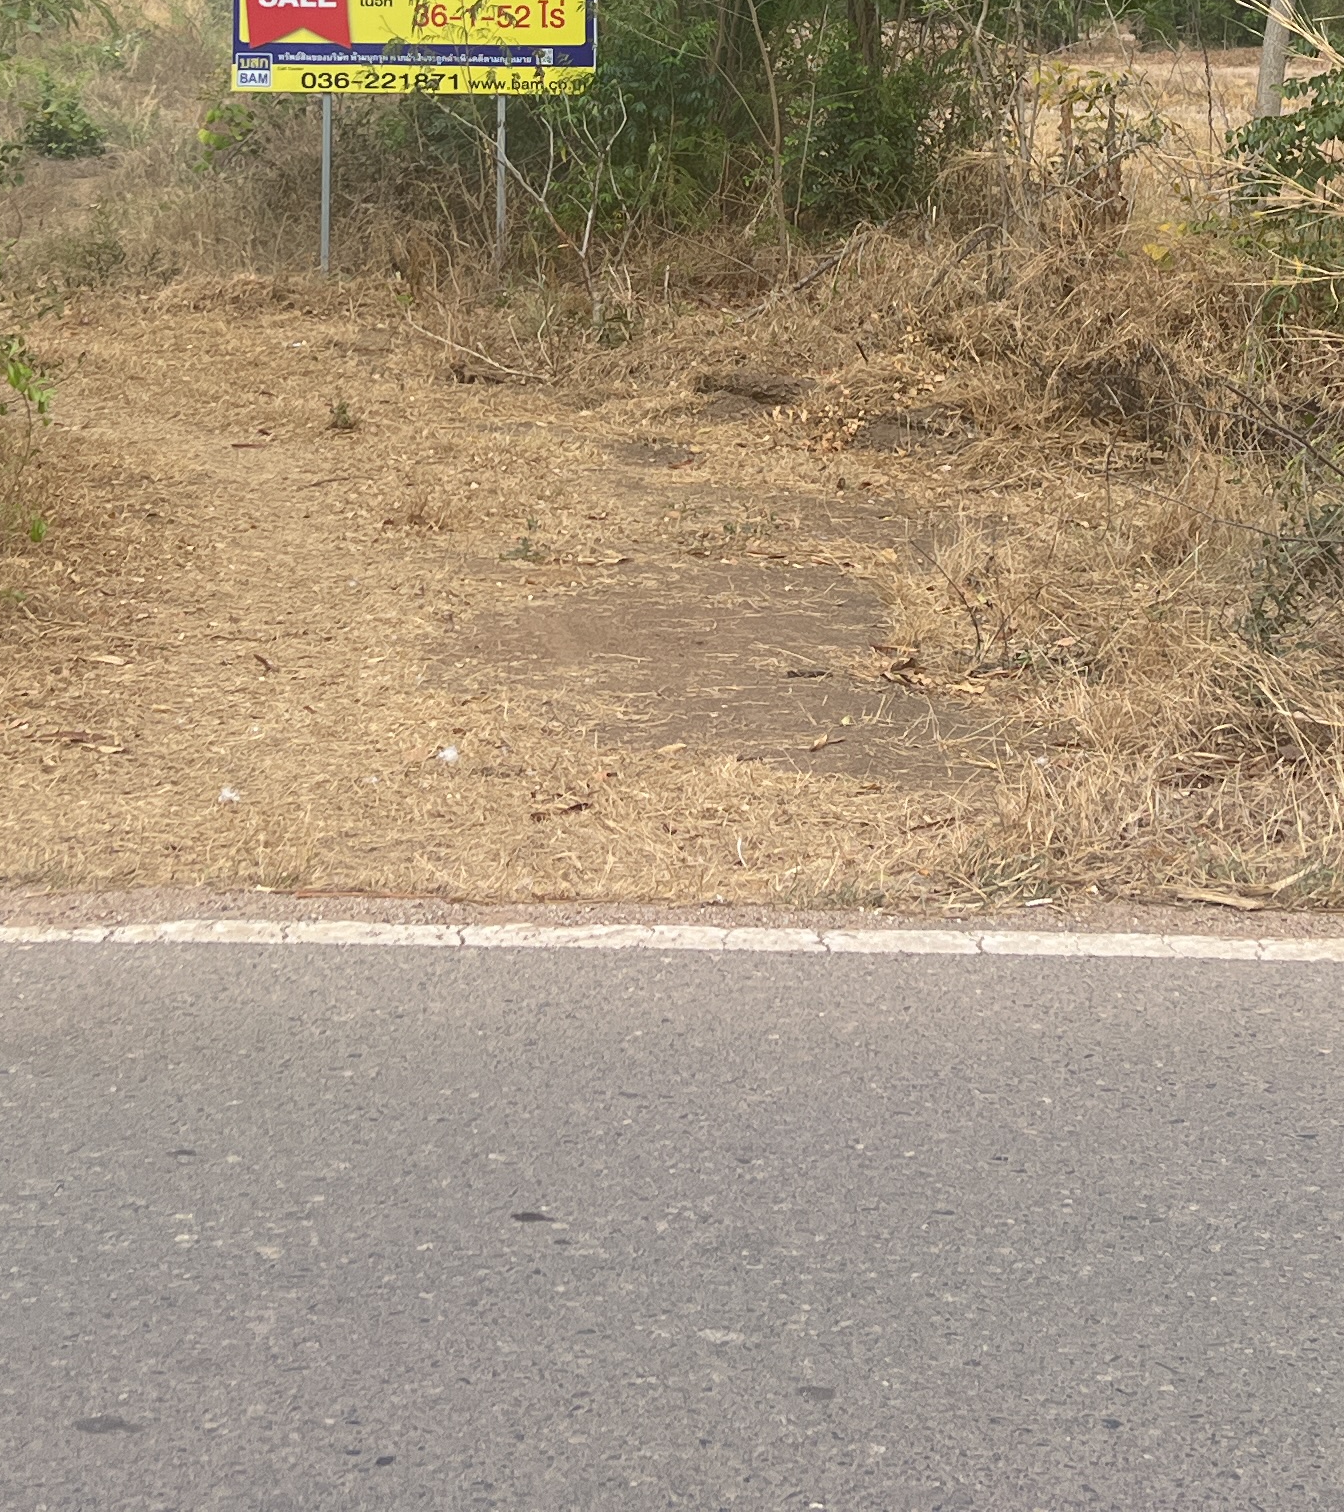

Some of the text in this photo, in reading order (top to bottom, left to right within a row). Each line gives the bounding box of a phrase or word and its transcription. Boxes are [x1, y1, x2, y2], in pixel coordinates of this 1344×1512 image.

[538, 0, 565, 29] ไร่
[240, 57, 268, 69] บสก
[240, 73, 268, 84] BAM
[301, 72, 458, 90] 036-221871
